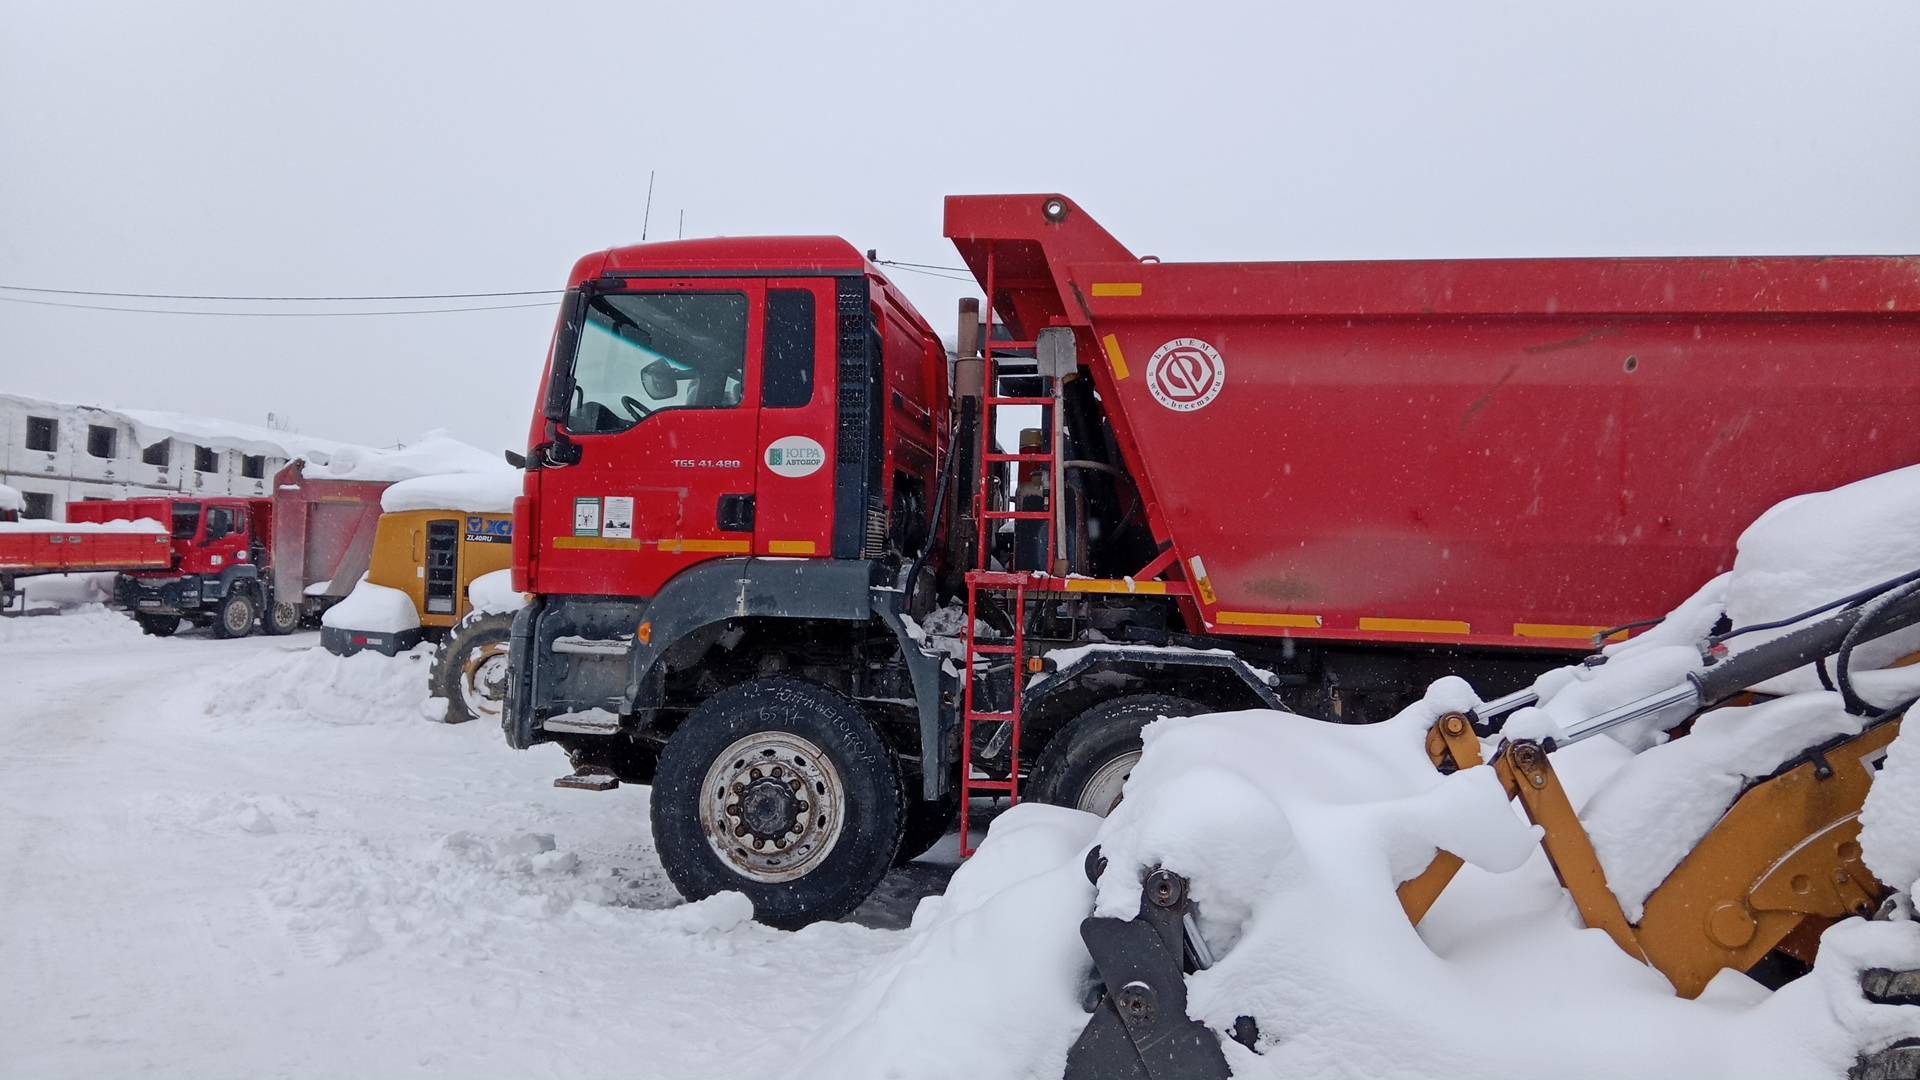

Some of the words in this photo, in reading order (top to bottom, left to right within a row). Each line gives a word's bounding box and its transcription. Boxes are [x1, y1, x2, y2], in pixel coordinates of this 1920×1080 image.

[786, 448, 820, 458] ЮГРА
[673, 459, 695, 468] TGS
[698, 459, 741, 468] 41.480
[483, 520, 512, 536] XC
[466, 534, 493, 542] ZL40RU
